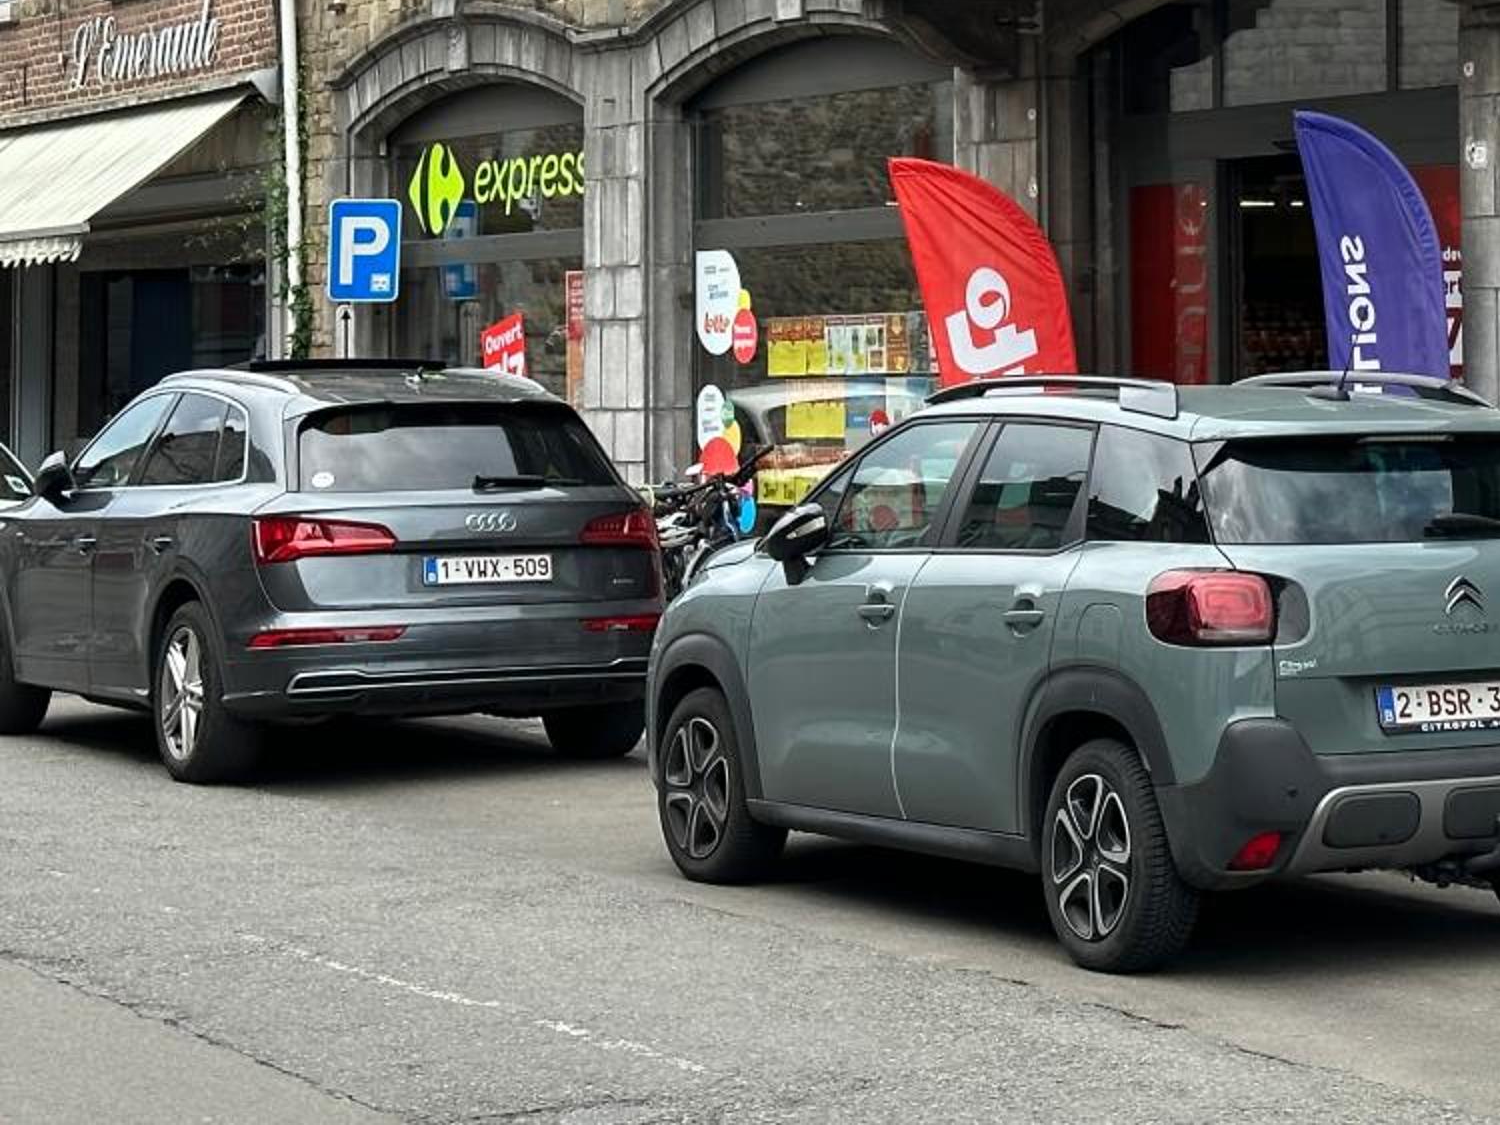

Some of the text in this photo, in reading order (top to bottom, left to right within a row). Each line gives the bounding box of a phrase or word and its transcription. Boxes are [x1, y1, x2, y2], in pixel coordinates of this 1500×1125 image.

[339, 216, 391, 286] P
[485, 321, 523, 356] Ouvert
[440, 557, 550, 580] 1-VWX-509
